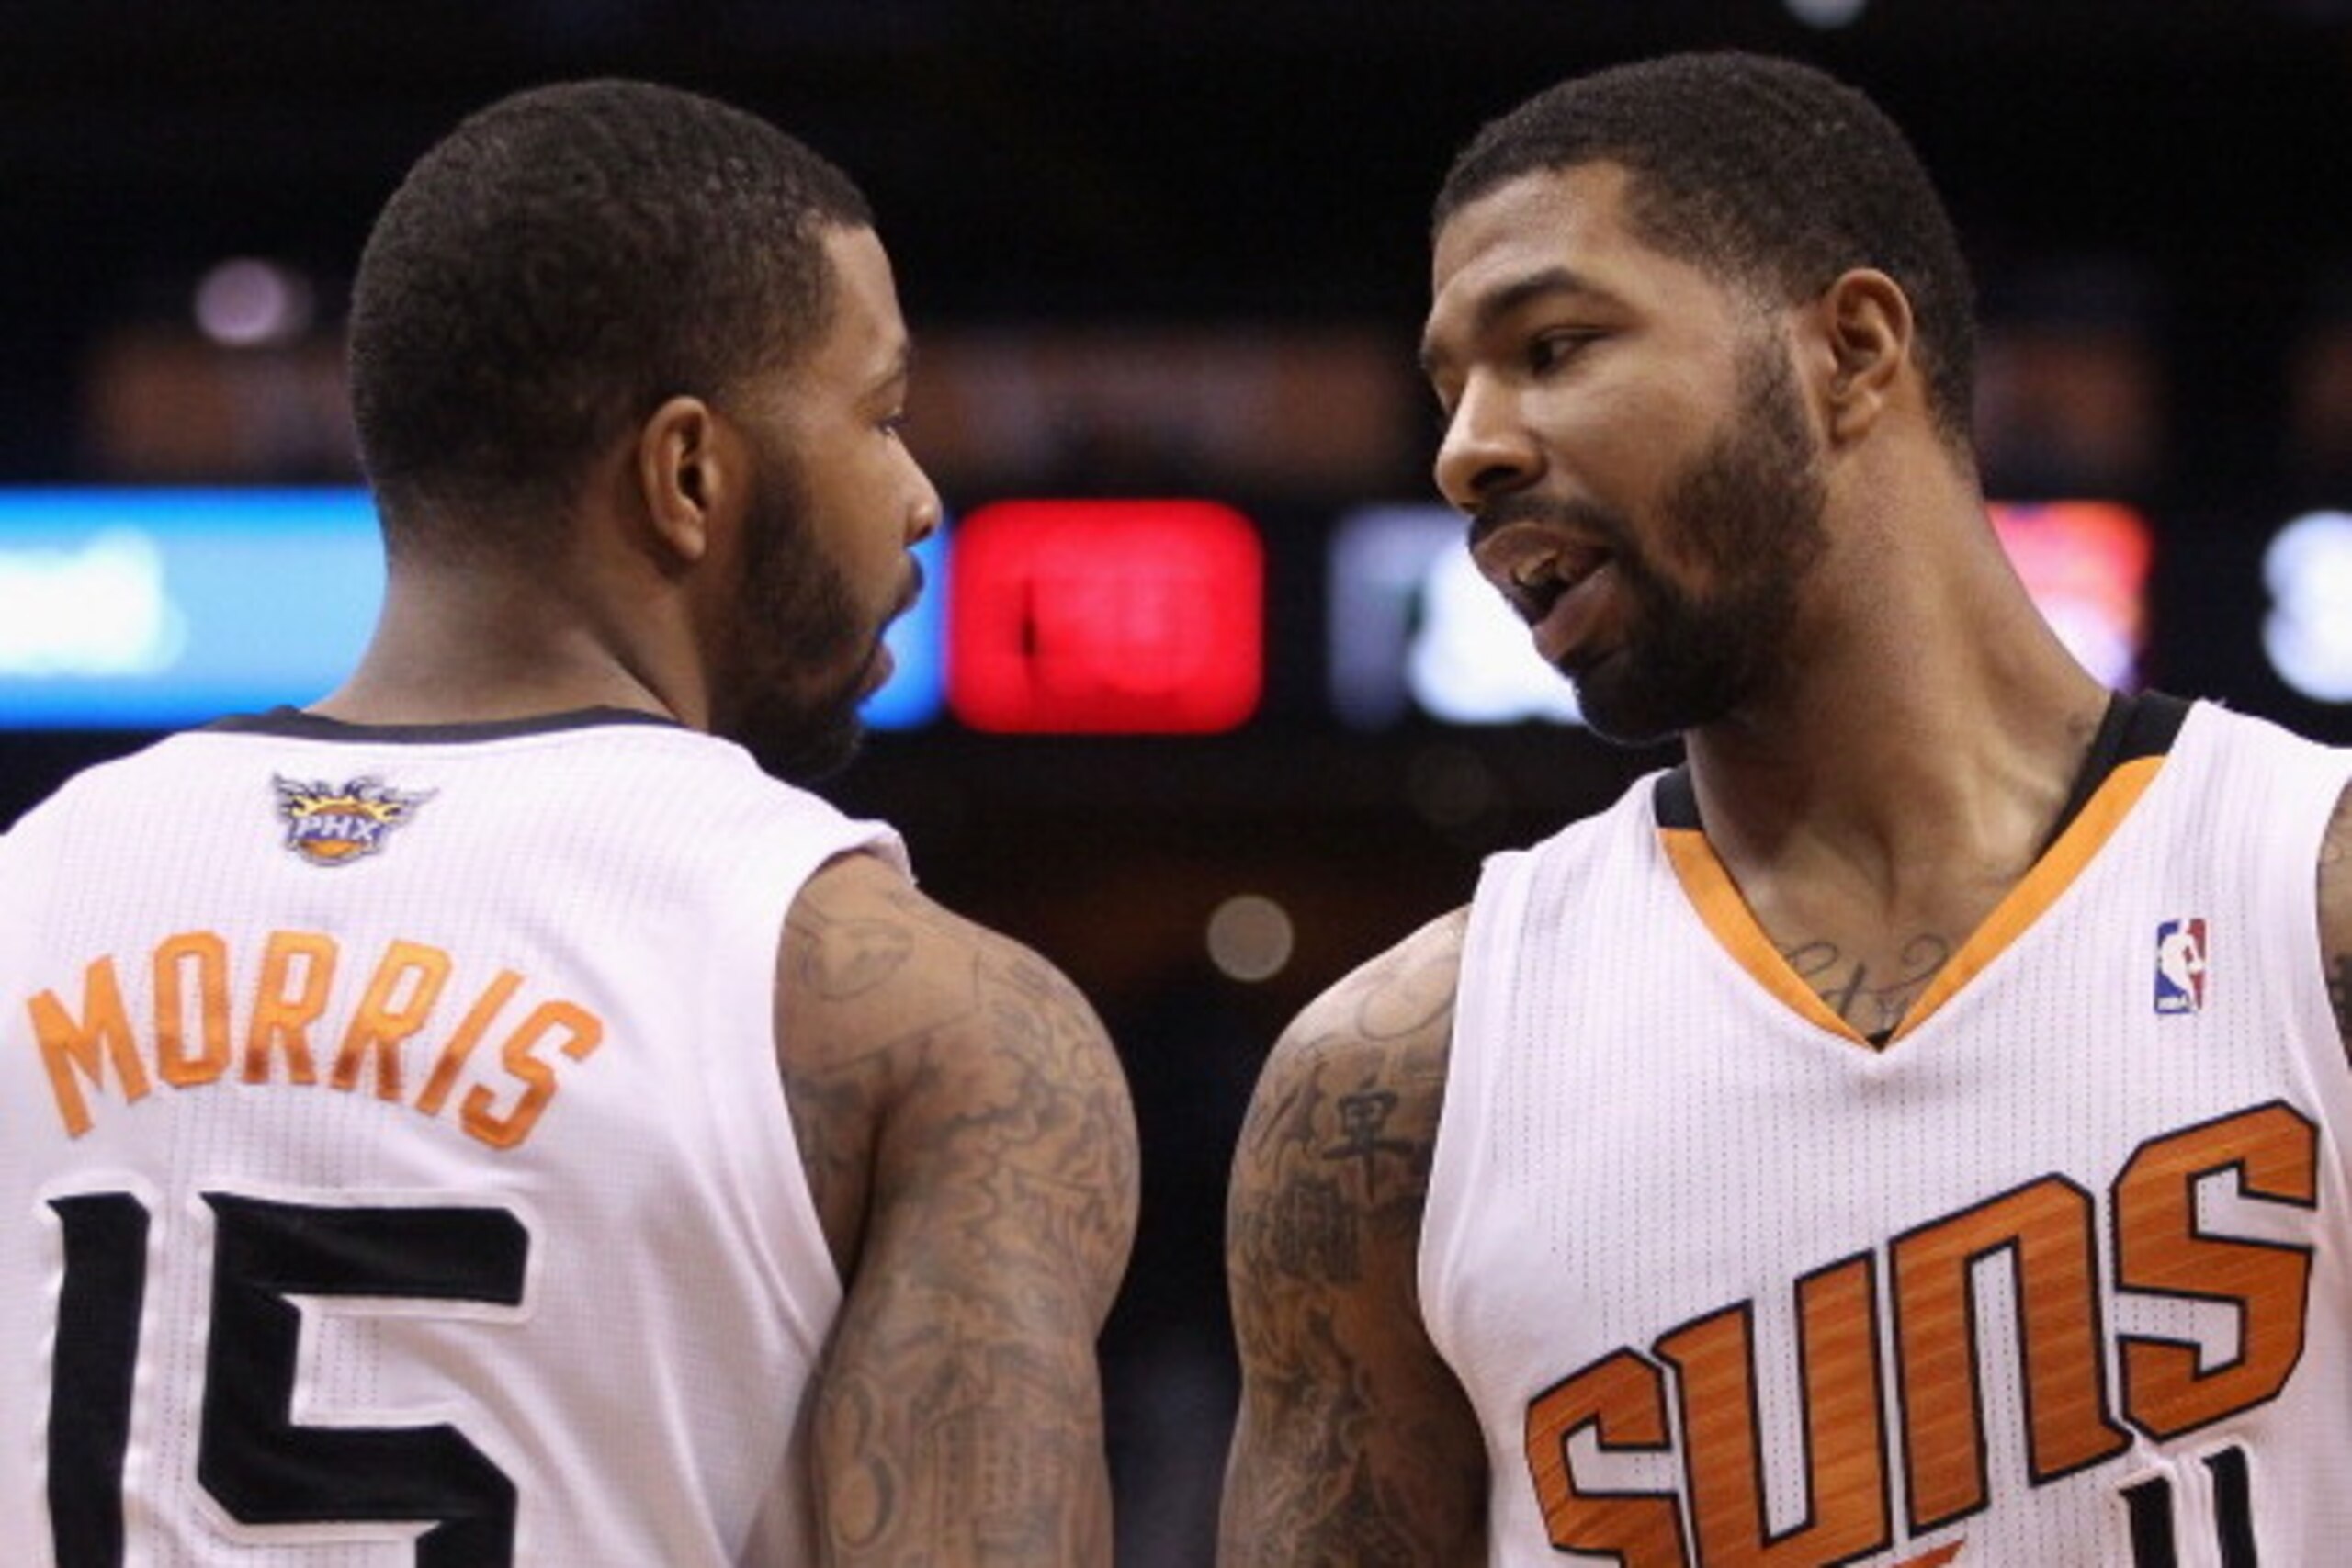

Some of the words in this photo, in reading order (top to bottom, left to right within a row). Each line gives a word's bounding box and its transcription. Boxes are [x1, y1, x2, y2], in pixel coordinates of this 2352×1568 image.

[293, 813, 379, 840] PHX
[26, 930, 605, 1150] MORRIS
[46, 1191, 530, 1568] 15
